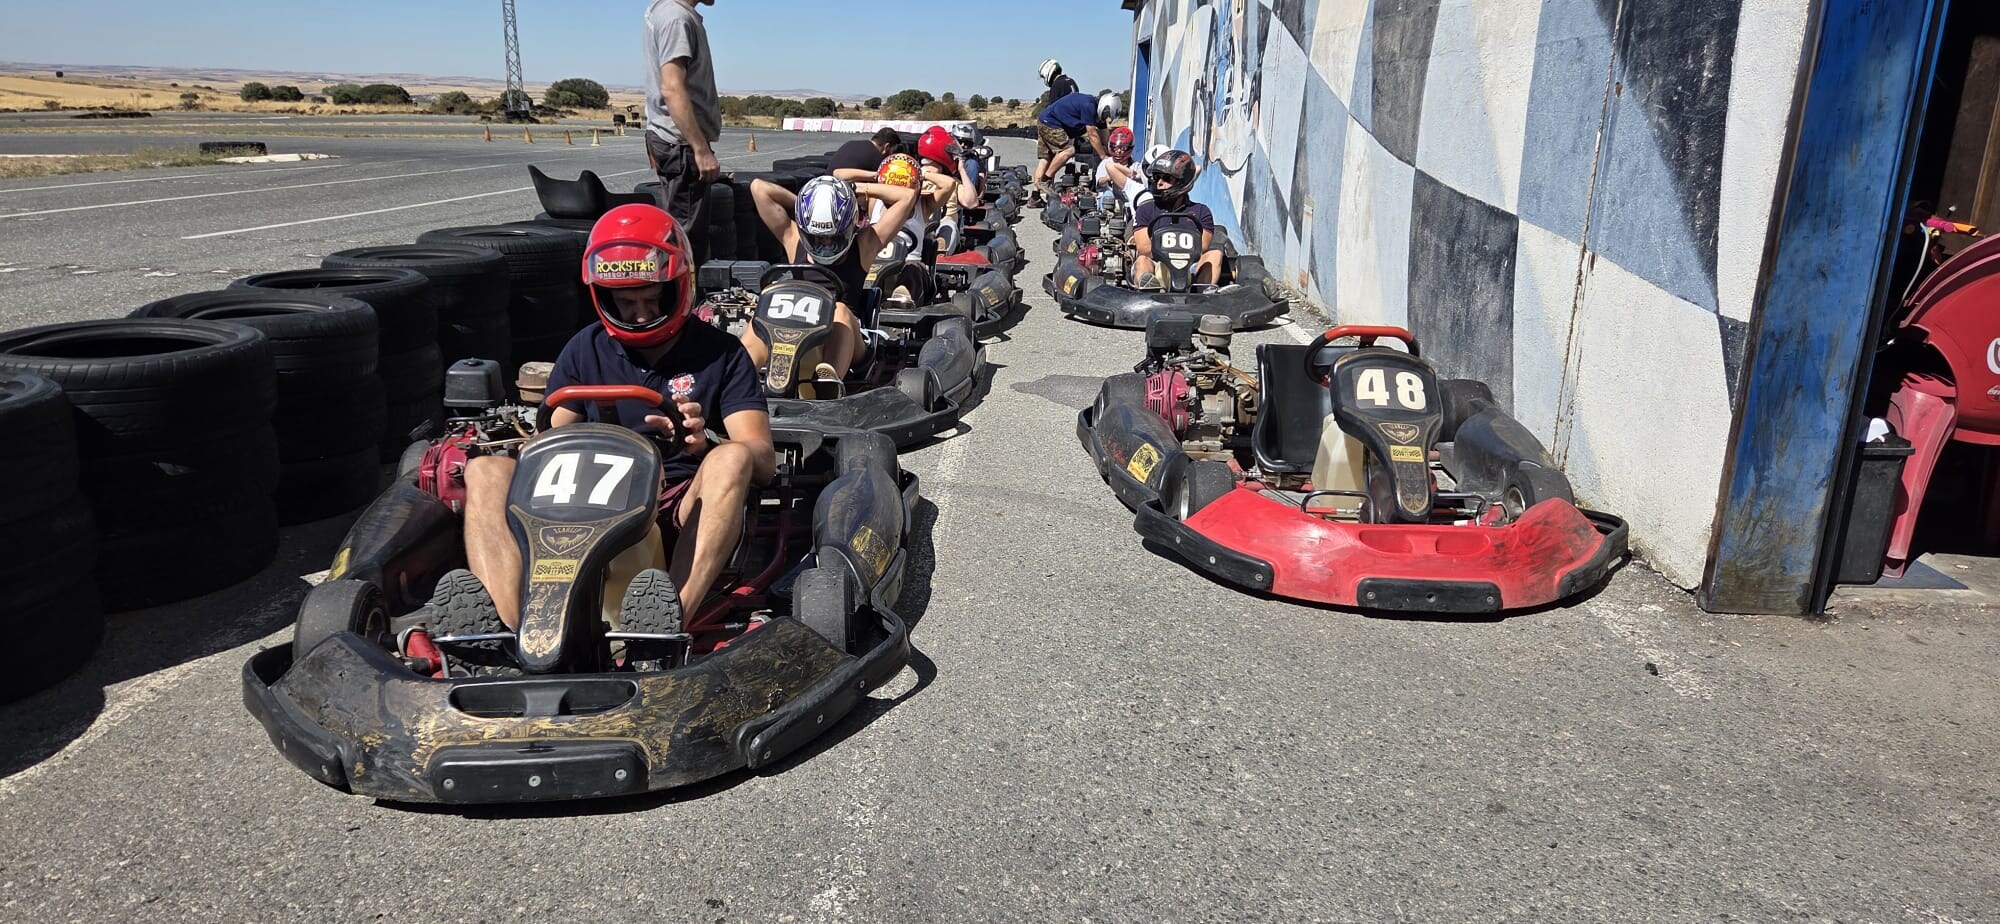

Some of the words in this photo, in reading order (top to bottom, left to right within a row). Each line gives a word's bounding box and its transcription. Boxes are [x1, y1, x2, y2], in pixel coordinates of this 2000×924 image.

[888, 171, 909, 181] Chupa
[811, 220, 833, 229] SHOEI
[1161, 231, 1194, 250] 60
[767, 293, 822, 325] 54
[1356, 368, 1426, 410] 48
[532, 452, 635, 506] 47
